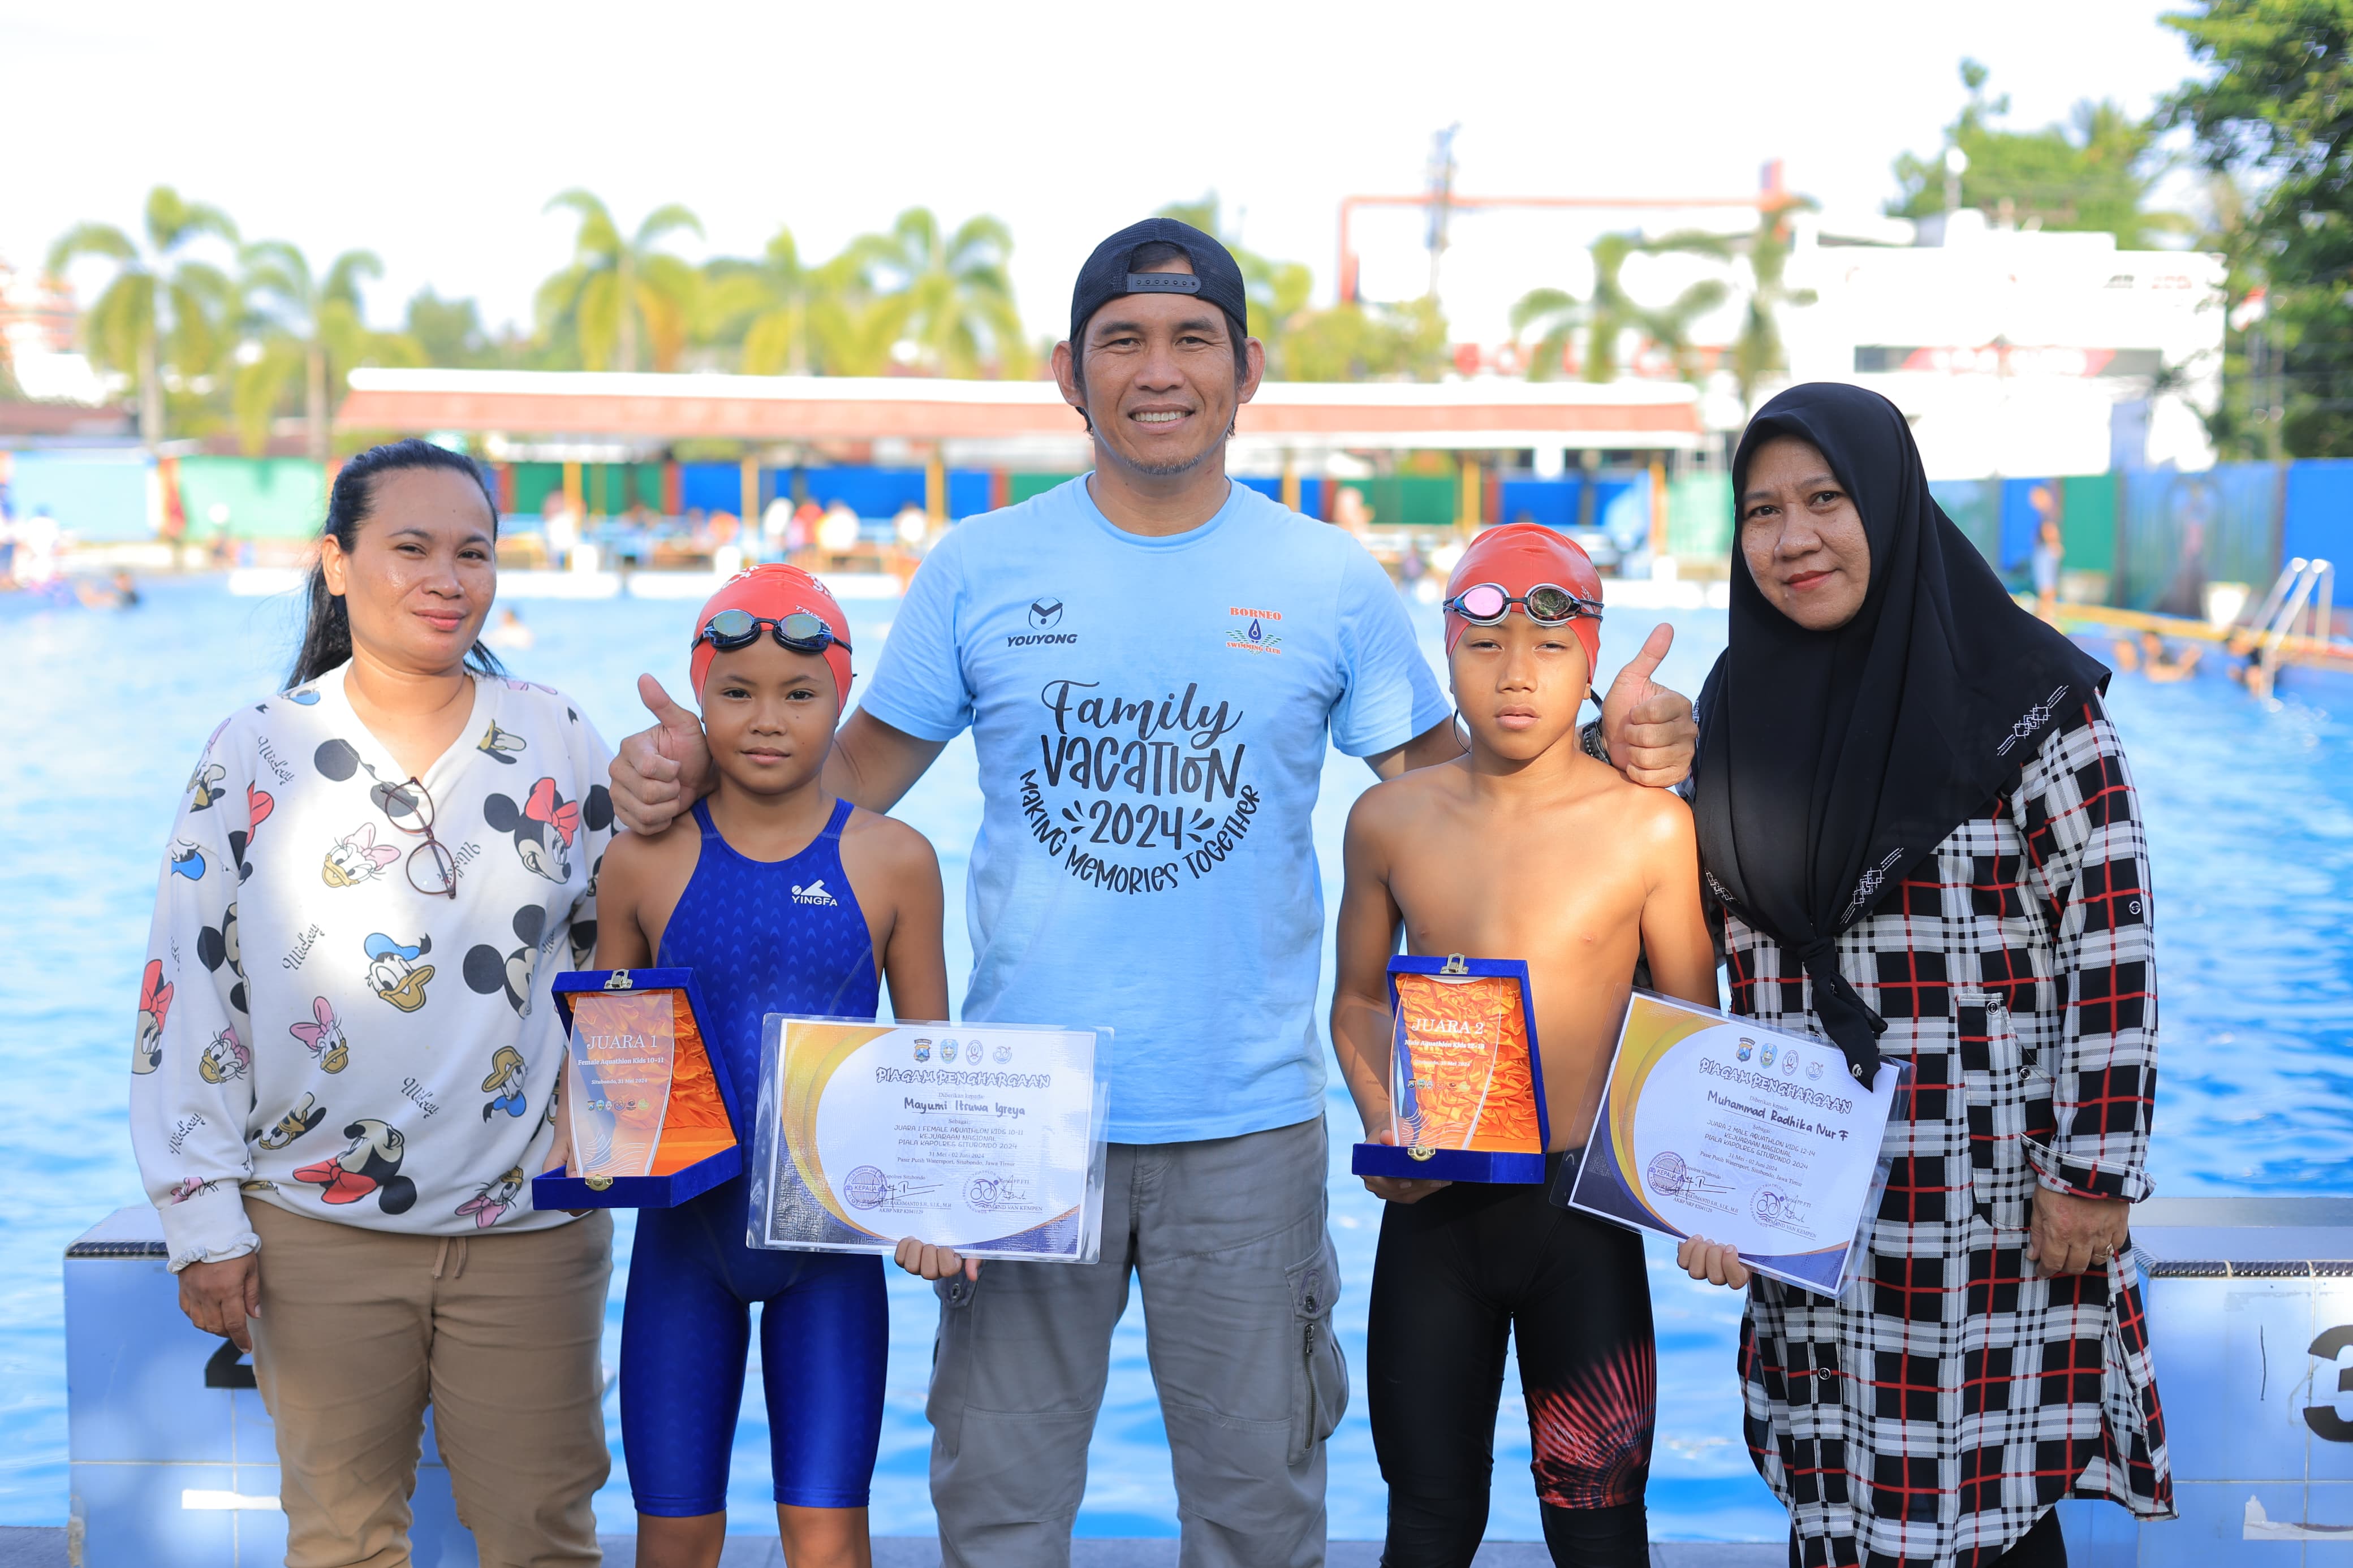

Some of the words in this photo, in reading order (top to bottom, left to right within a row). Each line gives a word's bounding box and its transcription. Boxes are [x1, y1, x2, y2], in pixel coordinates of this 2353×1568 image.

[1229, 607, 1282, 621] BORNEO
[1007, 634, 1078, 647] YOUYONG
[1226, 642, 1263, 651] SWIMMING
[1041, 680, 1243, 750] Family
[1089, 800, 1183, 850] 2024
[792, 896, 838, 906] YINGFA
[1411, 1018, 1471, 1034] JUARA
[1475, 1022, 1484, 1034] 2
[587, 1034, 645, 1049] JUARA
[650, 1035, 658, 1048] 1
[876, 1068, 936, 1084] PIAGAM
[936, 1070, 1050, 1088] PENGHARGAAN
[1700, 1057, 1750, 1084] PIAGAM
[1751, 1073, 1852, 1113] PENGHARGAAN
[904, 1097, 947, 1114] Mayumi
[996, 1102, 1025, 1119] Igreya
[1749, 1095, 1772, 1107] Diberikan
[1772, 1102, 1790, 1112] kepada:
[1707, 1090, 1766, 1119] Muhammad
[1771, 1109, 1813, 1131] Radhika
[1816, 1123, 1837, 1139] Nur
[1707, 1120, 1726, 1129] JUARA
[1733, 1128, 1748, 1136] MALE
[1749, 1132, 1784, 1147] AQUATHLON
[1785, 1143, 1799, 1152] KIDS
[1800, 1148, 1816, 1157] 12-14
[1724, 1132, 1760, 1147] KEJUARAAN
[1761, 1144, 1791, 1157] NASIONAL
[1705, 1134, 1722, 1143] PIALA
[1723, 1139, 1755, 1154] KAPOLRES
[1756, 1150, 1791, 1164] SITUBONDO
[1792, 1160, 1808, 1169] 2024
[1657, 1168, 1677, 1179] KEPALA
[1701, 1169, 1721, 1180] Situbondo
[1725, 1159, 1750, 1171] Watersport,
[1789, 1178, 1803, 1187] Timur
[1796, 1228, 1816, 1238] KEMPEN
